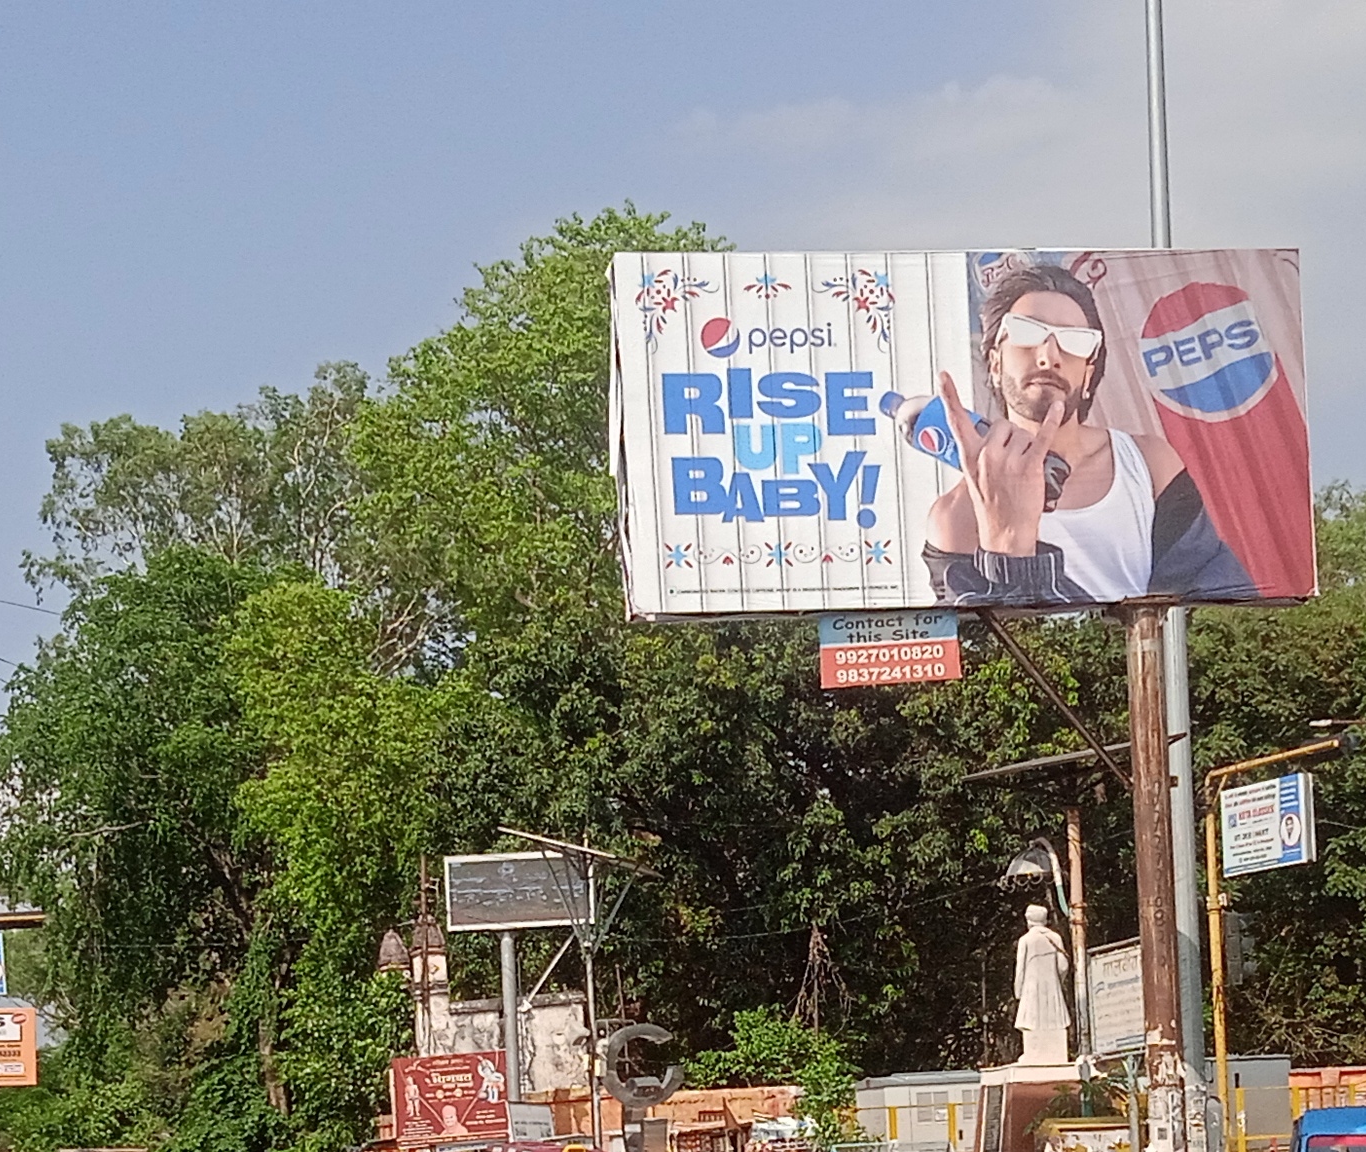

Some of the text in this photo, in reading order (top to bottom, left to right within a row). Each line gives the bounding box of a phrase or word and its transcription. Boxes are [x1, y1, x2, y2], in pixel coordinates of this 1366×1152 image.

[747, 322, 834, 354] pepsi
[1142, 319, 1260, 378] PEPS
[661, 367, 877, 436] RISE
[733, 421, 823, 475] UP
[671, 450, 882, 530] BABY!
[832, 613, 943, 631] Contact for
[847, 629, 931, 644] this Site
[835, 644, 944, 665] 9927010820
[836, 662, 945, 684] 9837241310
